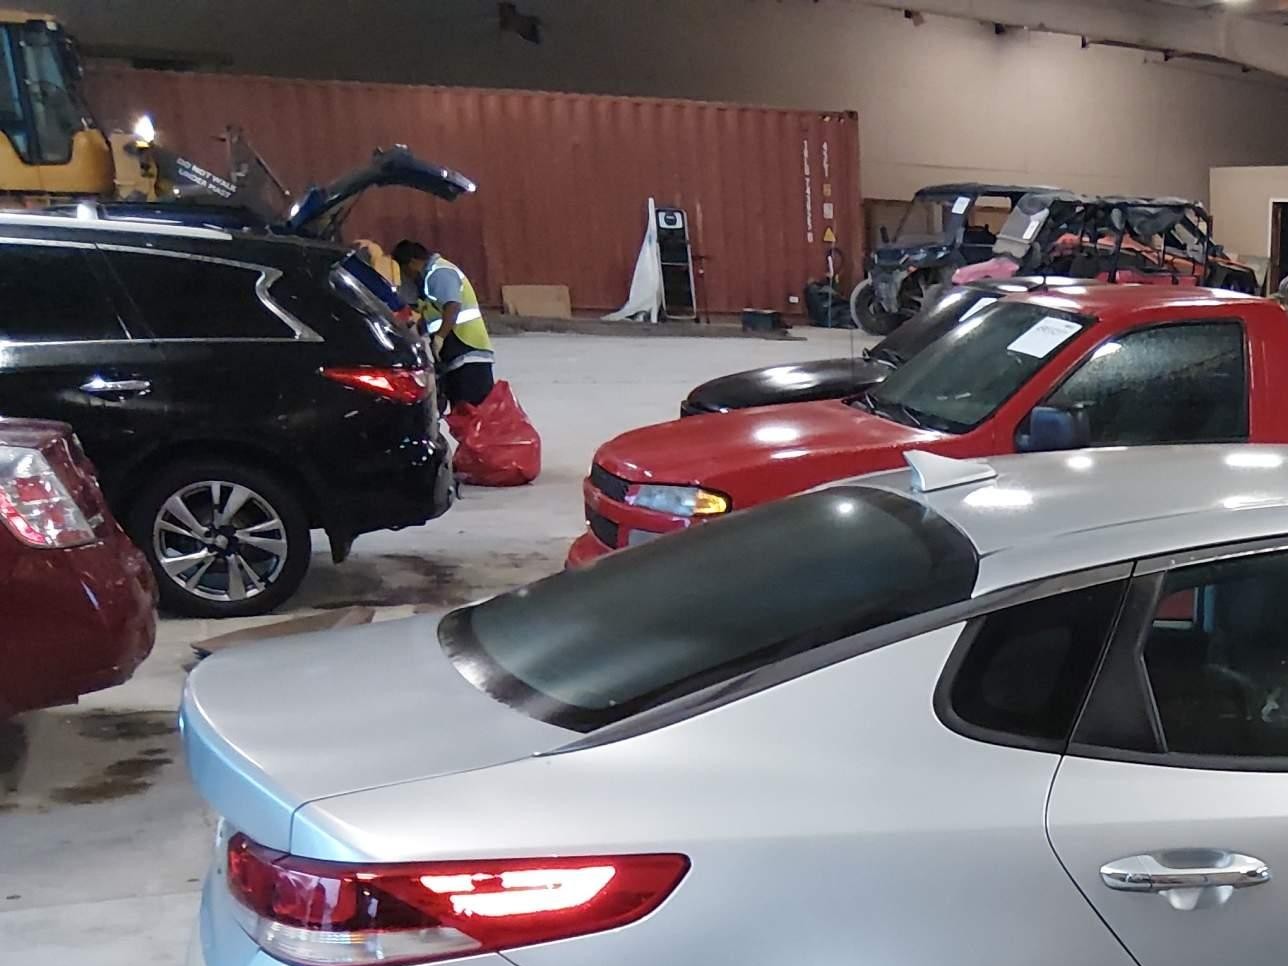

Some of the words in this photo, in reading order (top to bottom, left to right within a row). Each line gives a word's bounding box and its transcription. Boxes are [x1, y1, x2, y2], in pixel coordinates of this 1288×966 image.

[178, 168, 207, 186] UNDER
[208, 183, 232, 198] MAST
[192, 164, 213, 179] NOT
[212, 175, 238, 193] WALK
